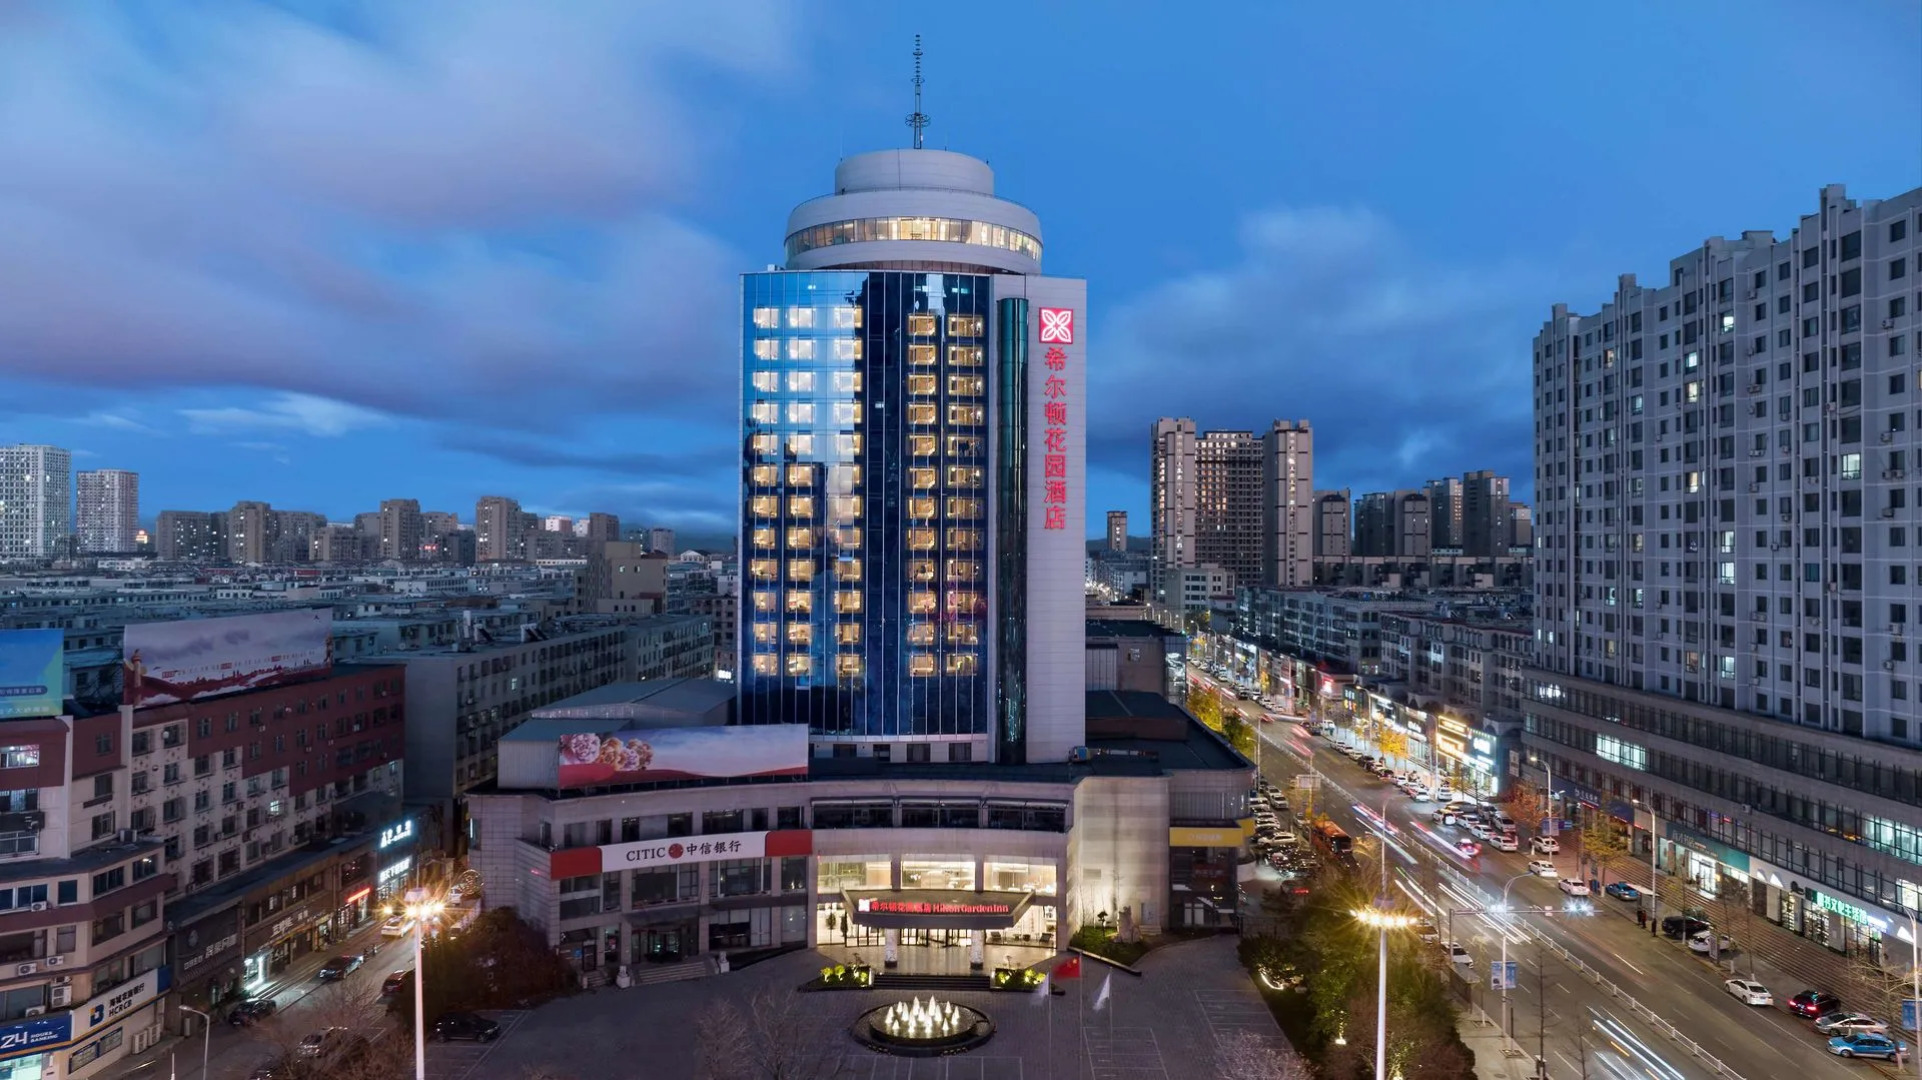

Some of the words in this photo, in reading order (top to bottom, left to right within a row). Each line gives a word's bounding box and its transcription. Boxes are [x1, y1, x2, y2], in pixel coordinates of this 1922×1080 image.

[1044, 347, 1067, 530] 希尔顿花园酒店
[626, 847, 666, 861] CITIC
[686, 840, 741, 856] 中信银行
[0, 1031, 28, 1049] 24
